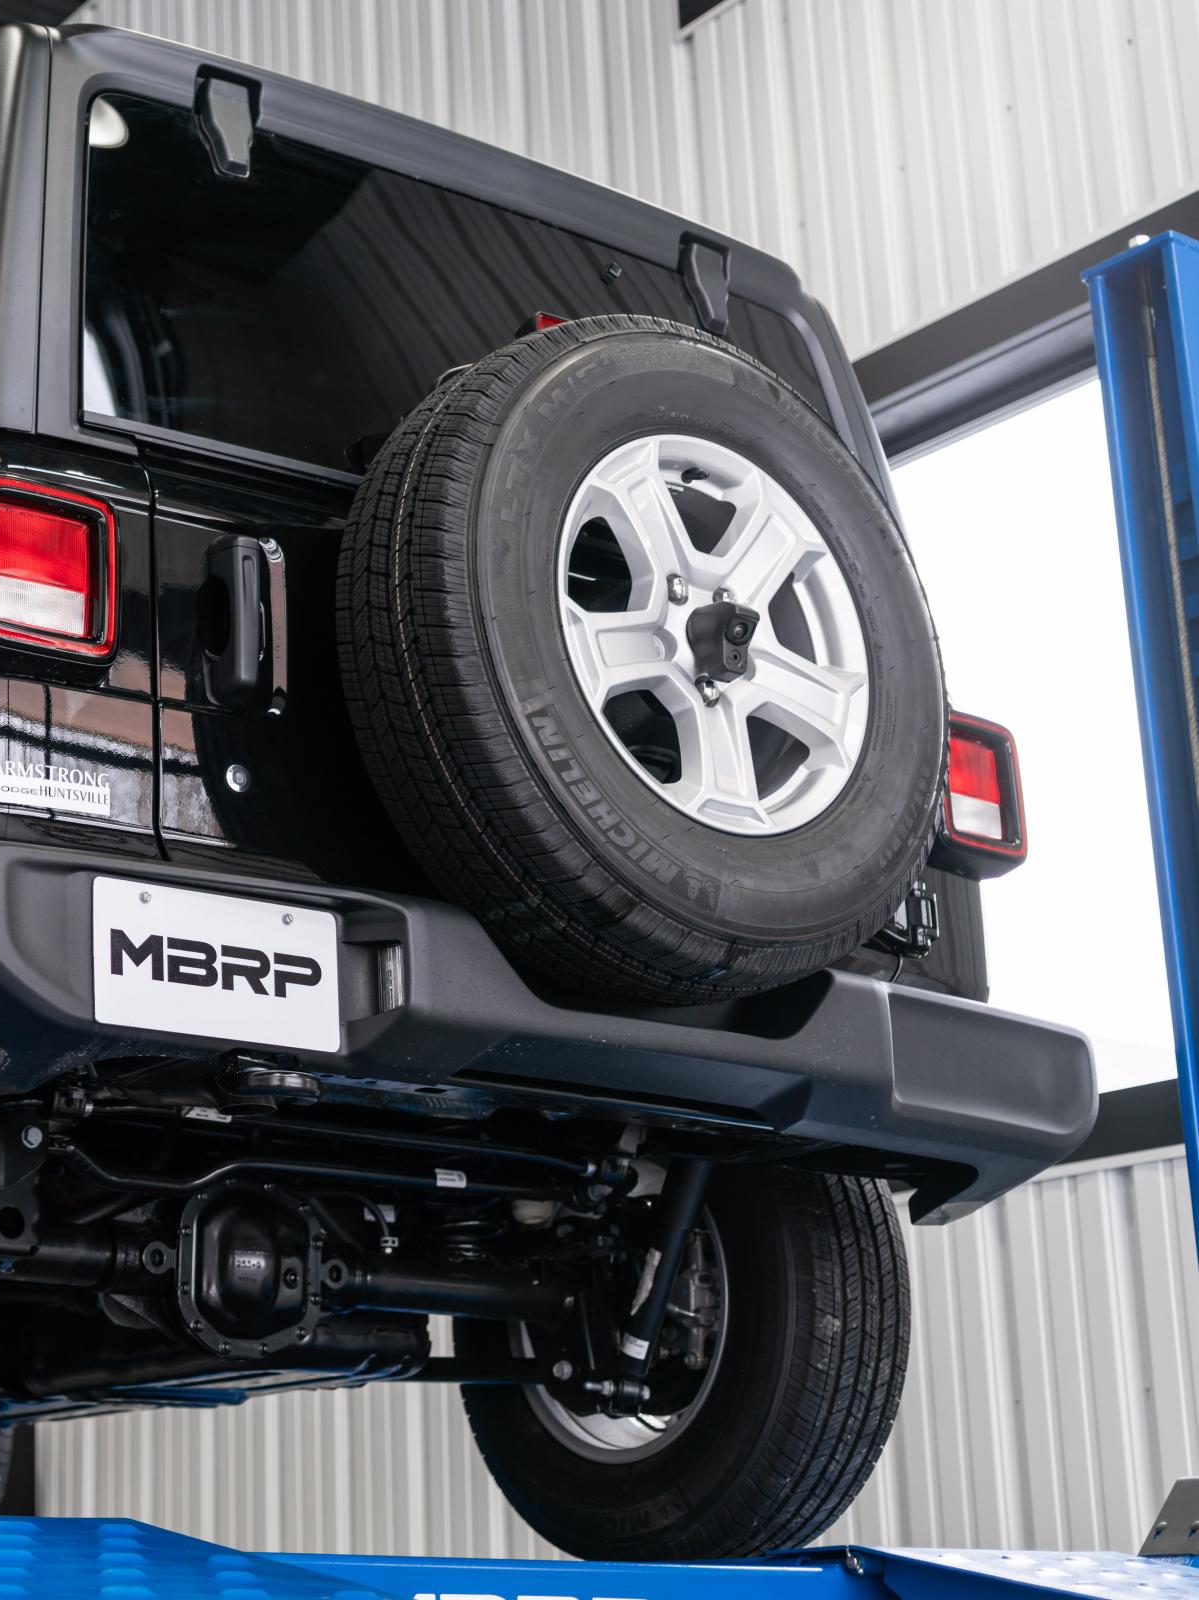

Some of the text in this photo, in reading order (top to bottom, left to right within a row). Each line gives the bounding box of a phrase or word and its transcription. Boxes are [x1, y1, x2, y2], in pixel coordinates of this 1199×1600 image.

[39, 785, 109, 805] HUNTSVILLE
[531, 715, 682, 886] MICHELIN
[110, 928, 322, 998] MBRP
